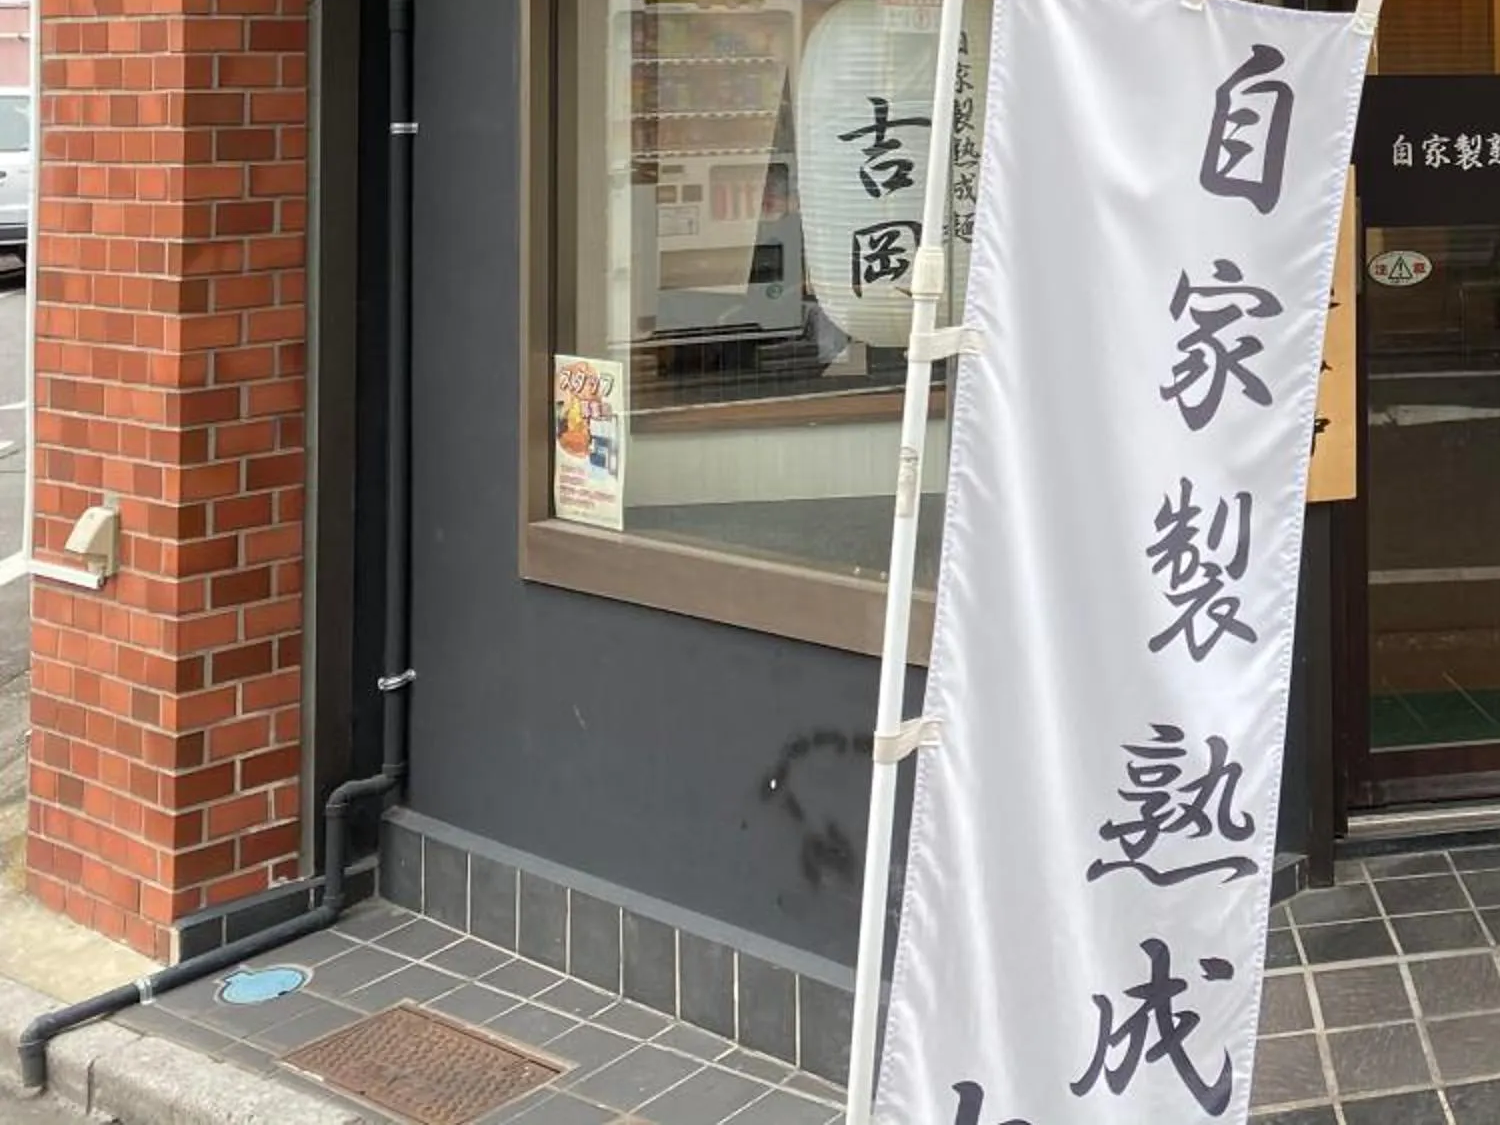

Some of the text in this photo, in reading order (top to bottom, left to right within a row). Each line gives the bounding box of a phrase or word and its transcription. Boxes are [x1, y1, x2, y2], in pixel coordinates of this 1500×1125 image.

[838, 97, 932, 298] 吉岡
[1070, 44, 1294, 1116] 自家製熟成
